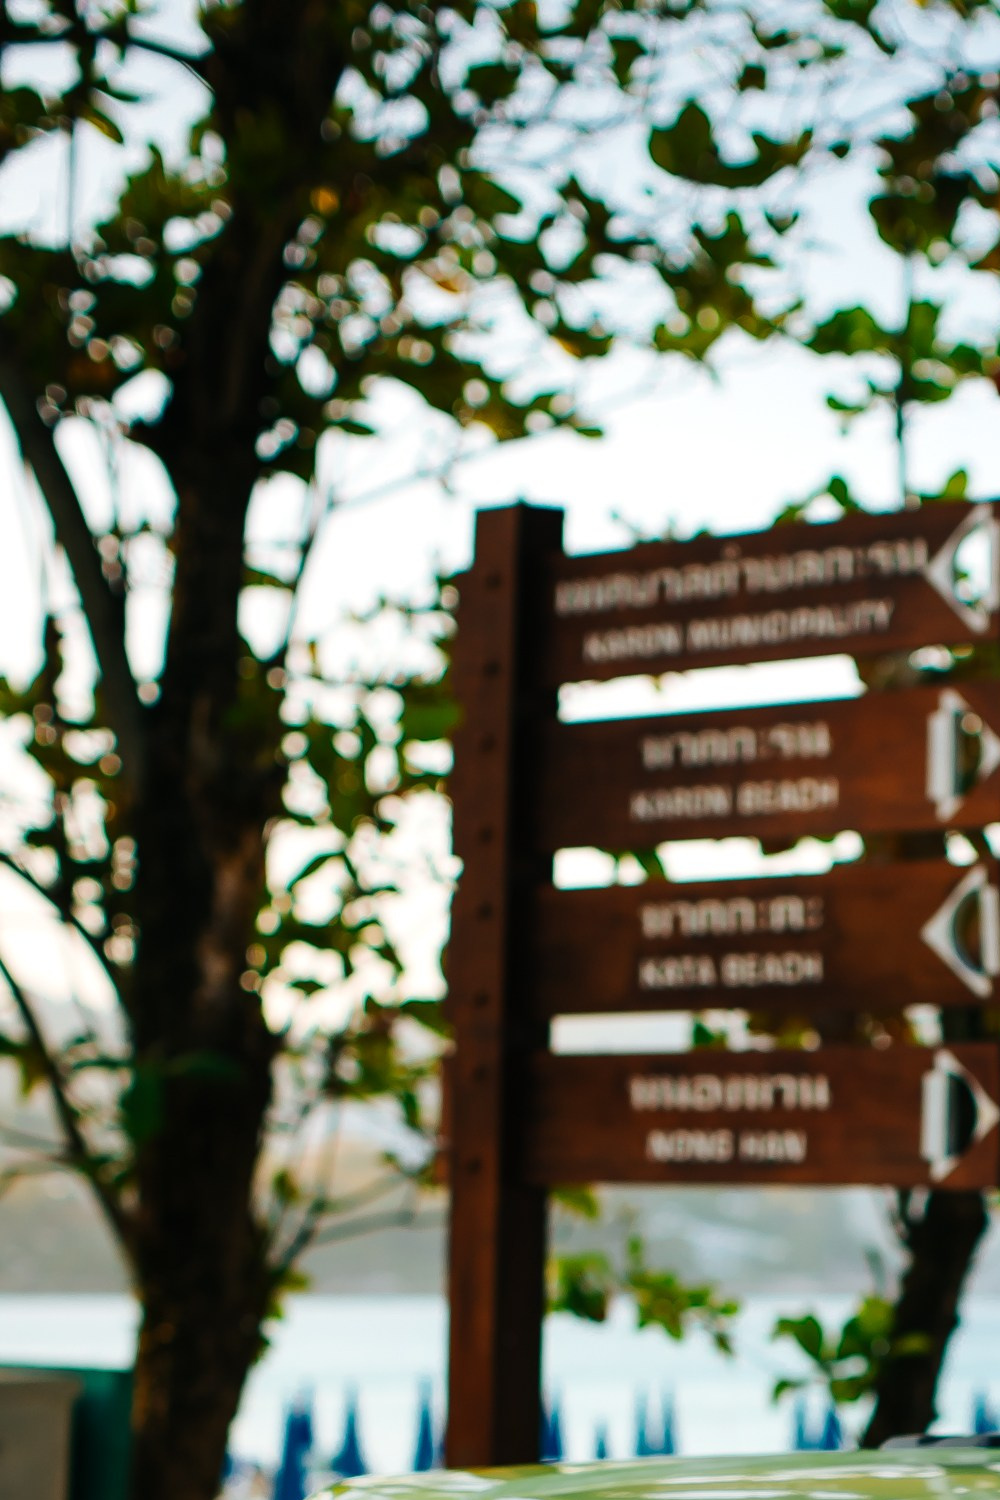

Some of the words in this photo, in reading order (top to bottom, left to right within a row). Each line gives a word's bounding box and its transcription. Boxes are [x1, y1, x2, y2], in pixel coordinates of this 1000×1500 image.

[687, 597, 894, 652] MUNICIPALITY
[737, 776, 839, 817] BEACH
[638, 954, 716, 990] KATA
[721, 951, 822, 986] BEACH
[740, 1129, 806, 1163] HAN
